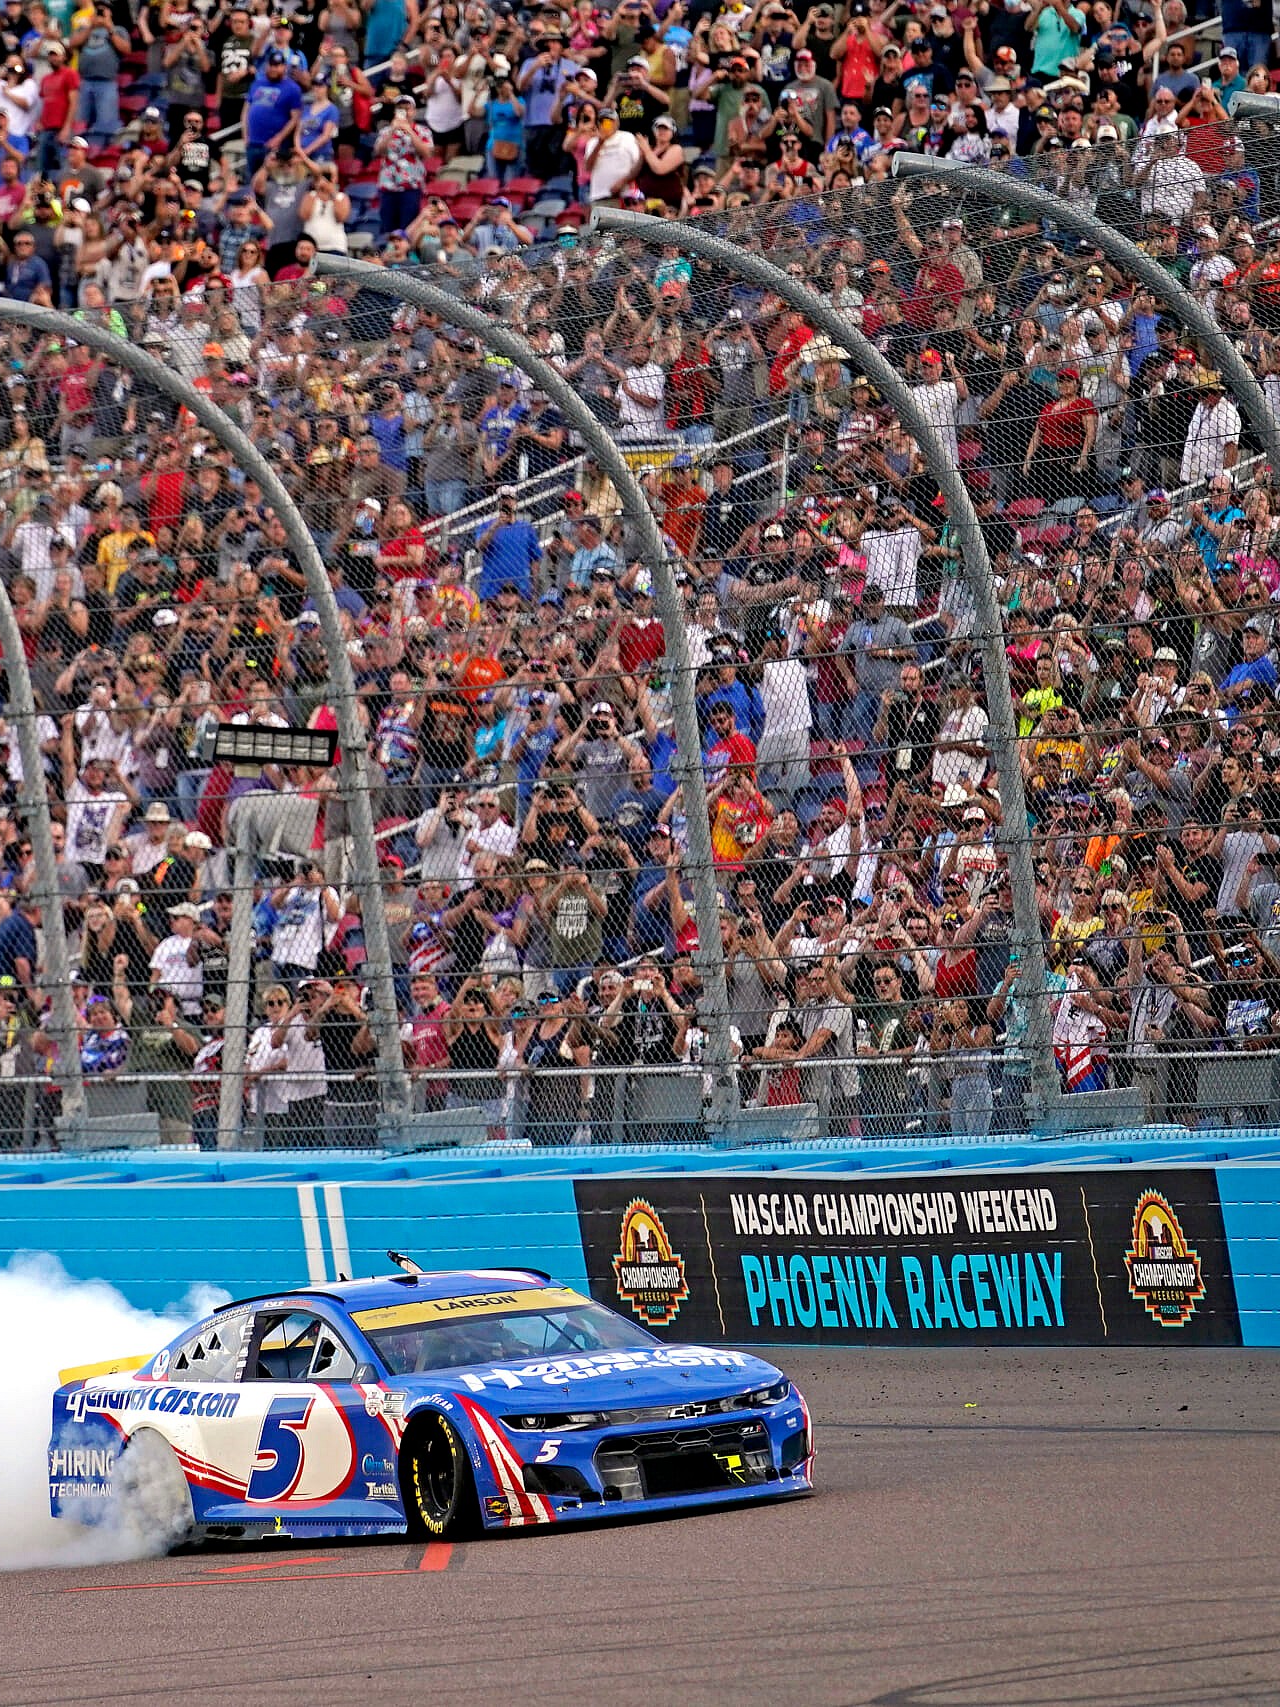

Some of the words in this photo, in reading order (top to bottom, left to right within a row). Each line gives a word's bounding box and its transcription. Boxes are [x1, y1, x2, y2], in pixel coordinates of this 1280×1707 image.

[730, 1194, 811, 1235] NASCAR
[814, 1192, 958, 1236] CHAMPIONSHIP
[960, 1189, 1057, 1233] WEEKEND
[621, 1267, 680, 1289] CHAMPIONSHIP
[1133, 1263, 1196, 1287] CHAMPIONSHIP
[638, 1291, 670, 1302] WEEKEND
[740, 1255, 898, 1329] PHOENIX
[901, 1252, 1065, 1329] RACEWAY
[1151, 1290, 1185, 1301] WEEKEND
[433, 1295, 518, 1311] LARSON
[246, 1394, 316, 1502] 5
[534, 1439, 563, 1463] 5
[50, 1449, 115, 1477] HIRING
